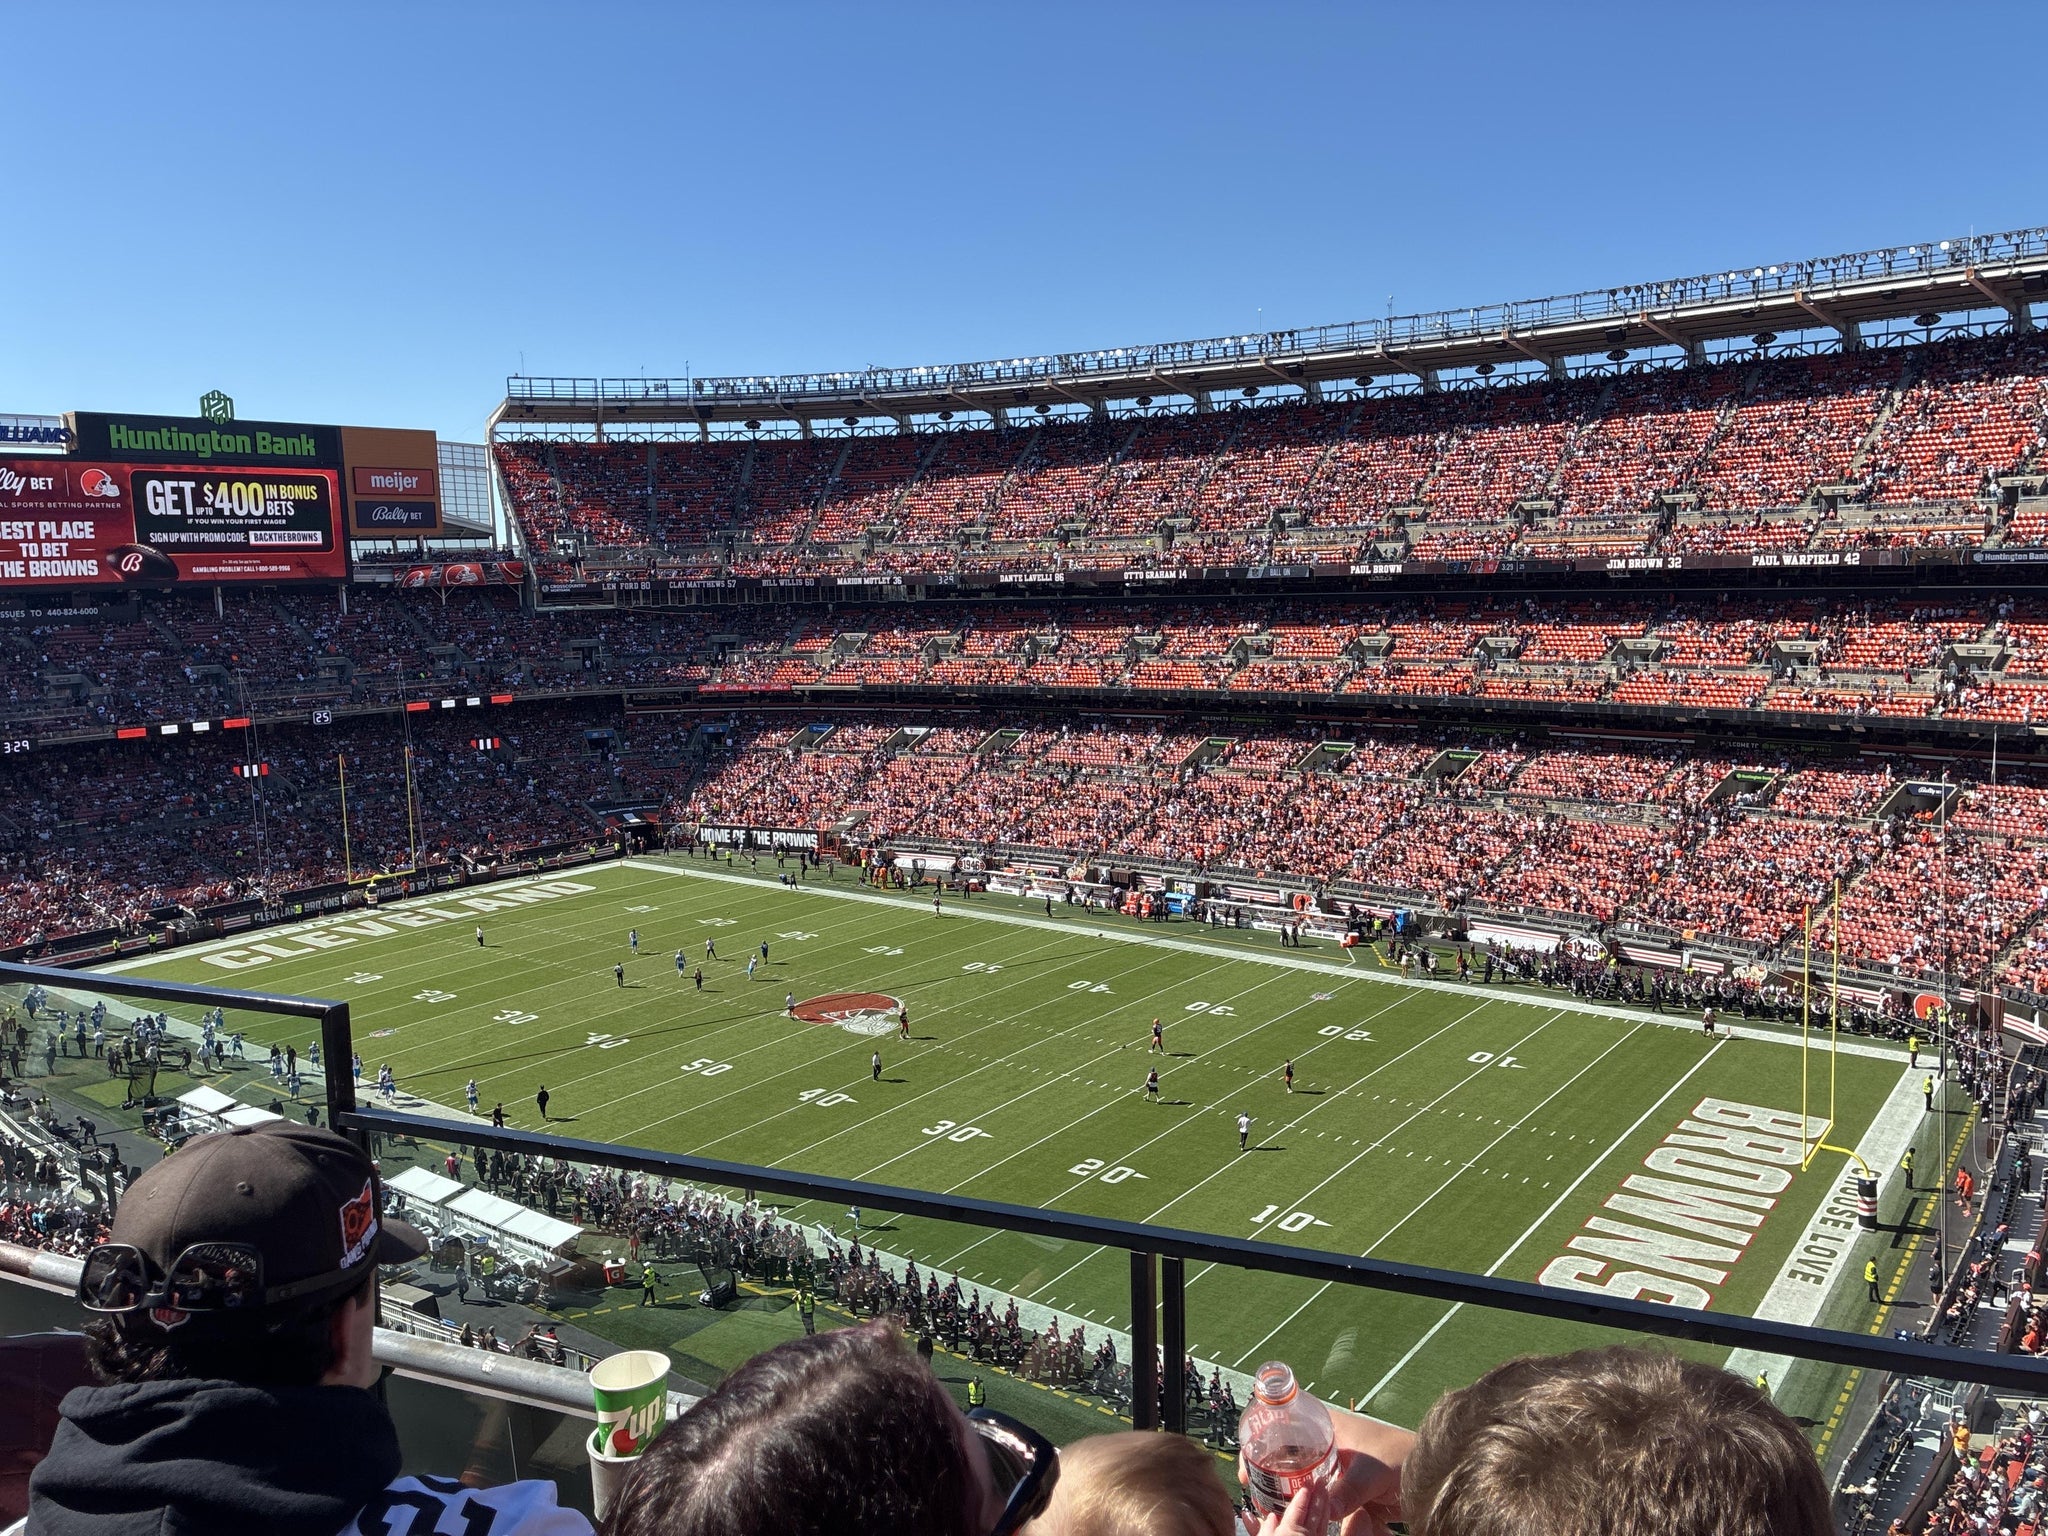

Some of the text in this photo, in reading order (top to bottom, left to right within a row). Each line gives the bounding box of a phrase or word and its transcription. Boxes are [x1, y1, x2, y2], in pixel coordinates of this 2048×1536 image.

[109, 424, 316, 458] Huntington Bank
[30, 477, 53, 490] BET
[371, 472, 418, 492] meijer
[146, 480, 196, 516] GET
[203, 482, 265, 517] $400
[265, 484, 318, 500] IN BONUS
[195, 506, 214, 516] UP TO
[267, 501, 295, 516] BETS
[372, 506, 422, 524] Bally BET
[0, 521, 95, 540] EST PLACE
[150, 532, 168, 543] SIGN
[169, 532, 180, 543] UP
[180, 532, 199, 543] WITH
[199, 532, 226, 543] PROMO
[254, 532, 318, 543] BACKTHEBROWNS
[19, 542, 69, 558] TO BET
[1985, 552, 2023, 562] Huntington
[1607, 556, 1681, 569] JIM BROWN 32
[1752, 552, 1861, 566] PAUL WARFIELD 42
[29, 559, 99, 577] BROWNS
[1124, 570, 1188, 580] OTTO GRAHAM 14
[1350, 564, 1402, 574] PAUL BROWN
[620, 582, 639, 590] FORD
[640, 581, 651, 590] 80
[669, 581, 685, 589] CLAY
[727, 579, 736, 588] 57
[893, 576, 902, 585] 36
[1000, 574, 1023, 583] DANTE
[1024, 573, 1053, 582] LAVELLI
[31, 610, 42, 618] TO
[47, 607, 98, 617] 440-824-6000
[316, 711, 329, 723] 25
[700, 827, 730, 843] HOME
[732, 829, 746, 843] OF
[751, 830, 771, 845] THE
[963, 858, 980, 870] 1946
[254, 904, 303, 922] CLEVELAN
[200, 881, 598, 970] CLEVELAND
[1573, 941, 1599, 957] 146
[412, 990, 458, 1003] 20
[493, 1010, 539, 1025] 30
[1317, 1025, 1371, 1040] 20
[585, 1033, 631, 1049] 40
[680, 1058, 734, 1076] 50
[1467, 1051, 1518, 1067] 10
[799, 1088, 849, 1107] 40
[922, 1120, 982, 1142] 30
[1068, 1158, 1135, 1184] 20
[1537, 1096, 1832, 1310] BROWNS
[1250, 1205, 1316, 1232] 10
[1786, 1232, 1846, 1286] LOVE
